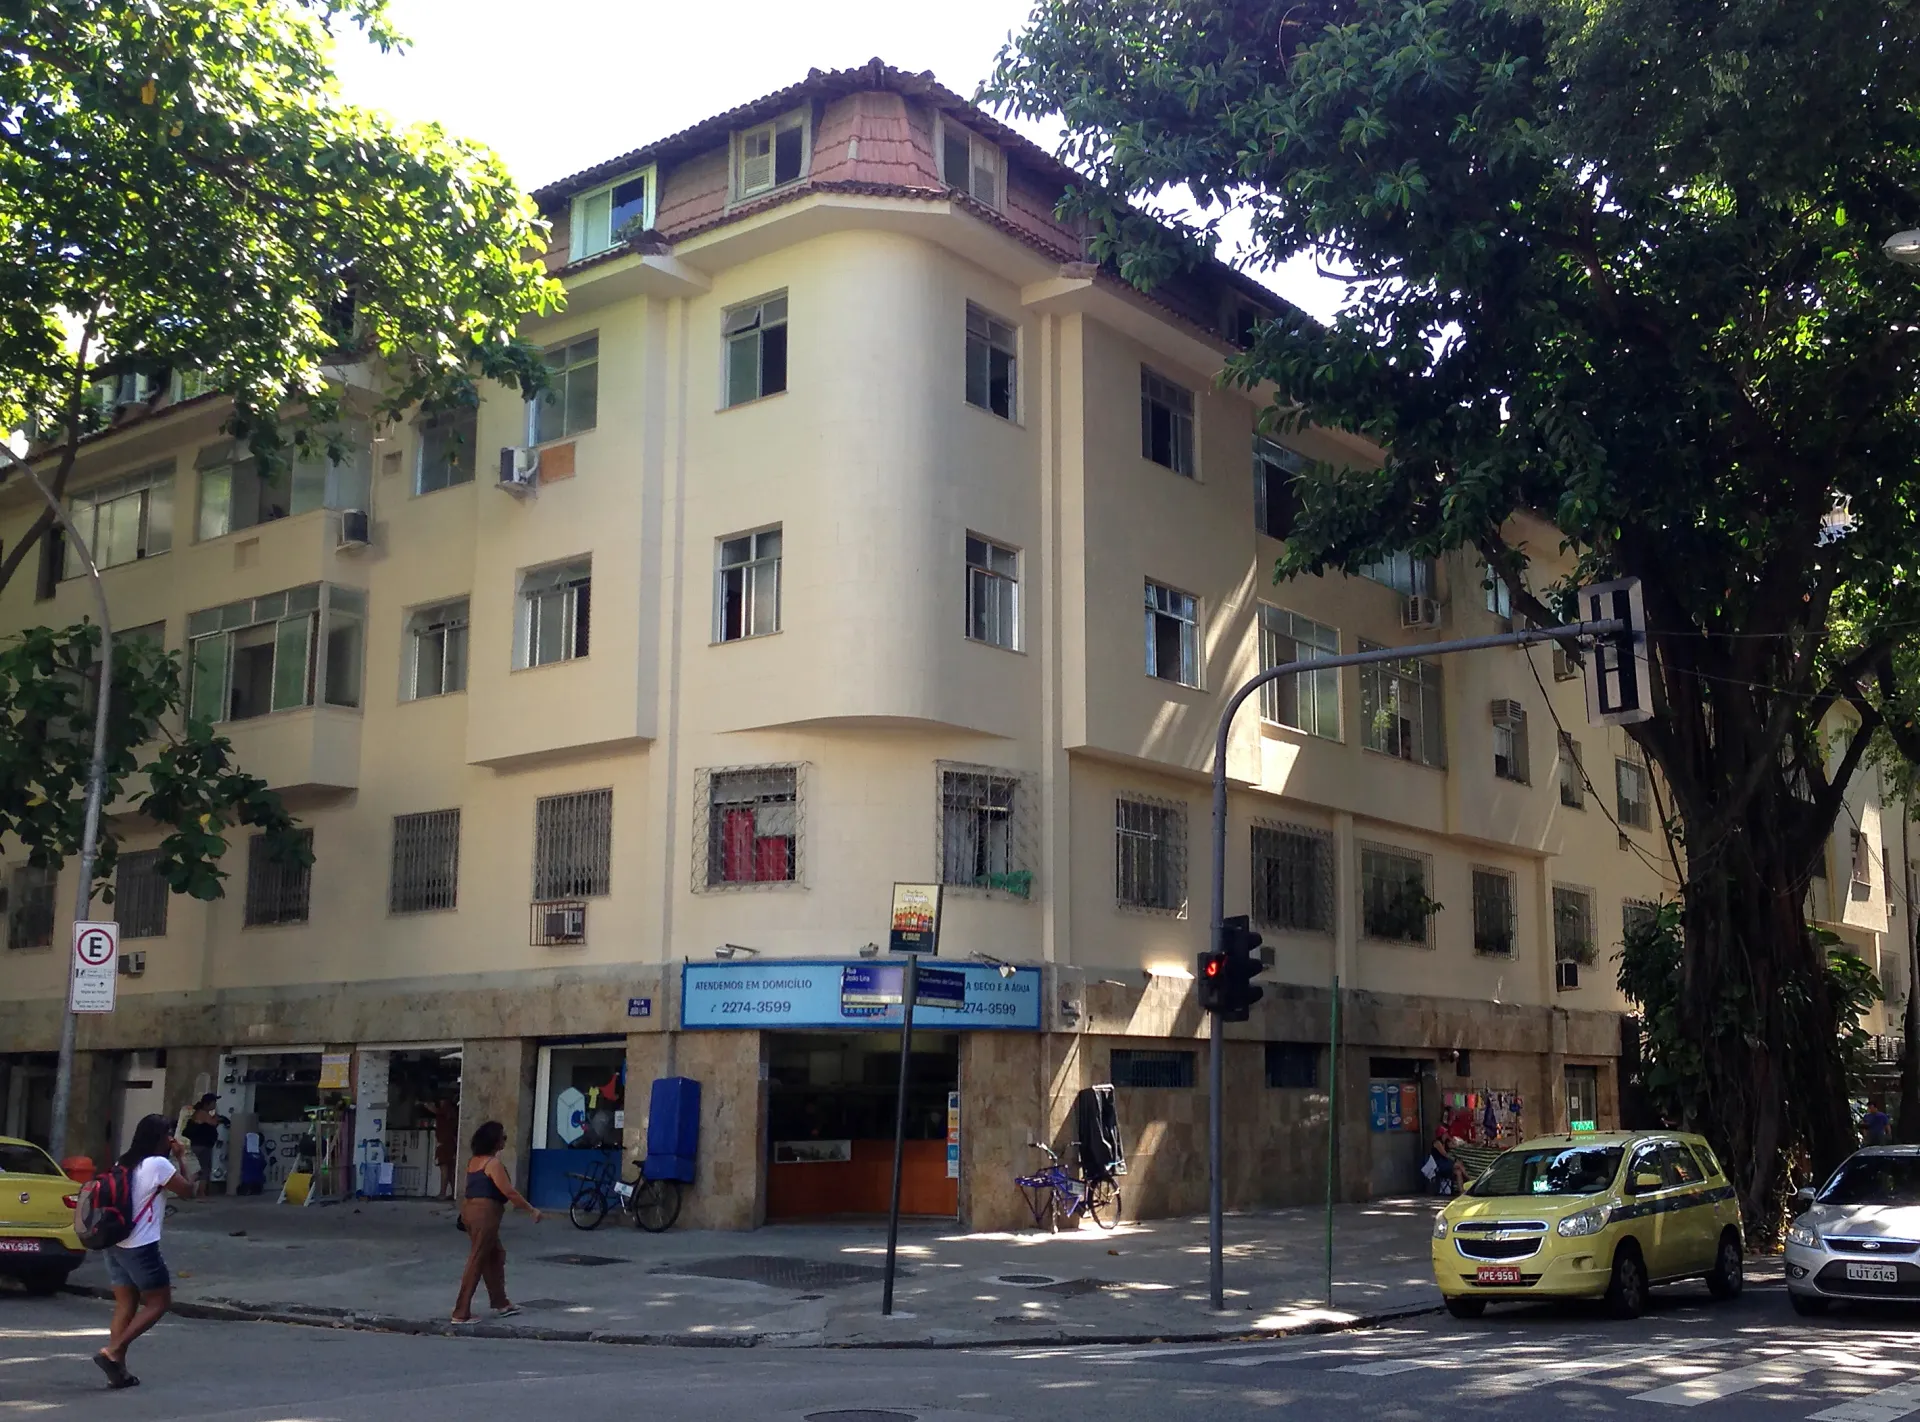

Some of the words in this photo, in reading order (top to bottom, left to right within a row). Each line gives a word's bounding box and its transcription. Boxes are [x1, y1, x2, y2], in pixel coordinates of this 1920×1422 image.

[89, 936, 102, 957] E
[695, 980, 743, 991] ATENDEMOS
[746, 979, 760, 989] EM
[762, 977, 813, 989] DOMICÍLIO
[973, 982, 996, 991] SECO
[997, 983, 1002, 991] E
[1004, 983, 1010, 991] A
[721, 1001, 792, 1013] 2274-3599
[1571, 1120, 1594, 1131] TAXI
